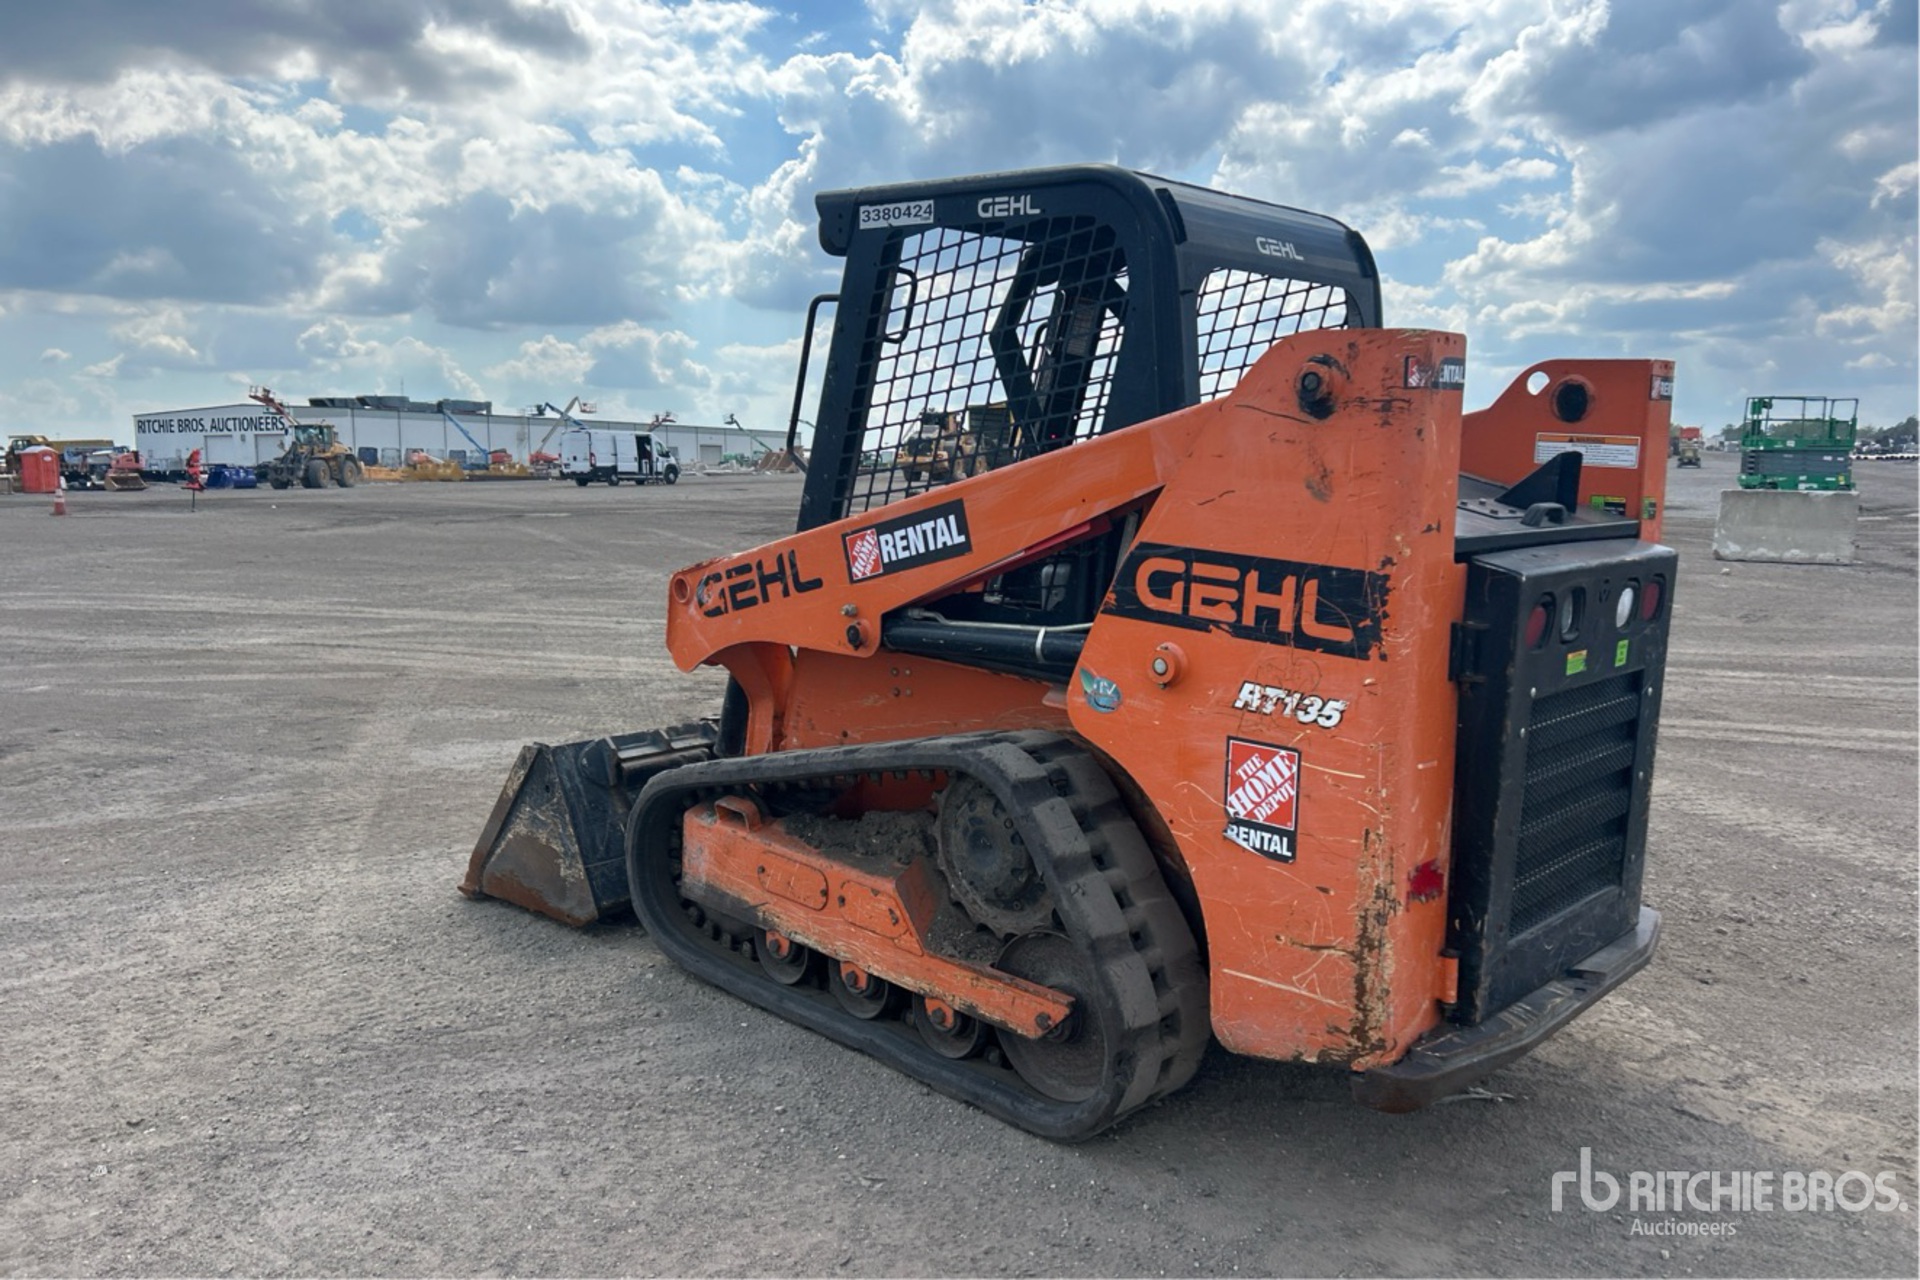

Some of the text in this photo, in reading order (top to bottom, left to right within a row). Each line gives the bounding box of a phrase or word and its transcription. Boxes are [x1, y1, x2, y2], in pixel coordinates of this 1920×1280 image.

[861, 203, 933, 222] 3380424
[977, 195, 1041, 218] GEHL
[1256, 236, 1304, 260] GEHL
[137, 416, 285, 434] RITCHIE BROS. AUCTIONEERS
[879, 514, 965, 563] RENTAL
[696, 549, 823, 617] GEHL
[1135, 557, 1354, 642] GEHL
[1232, 680, 1348, 729] RT135
[1227, 750, 1296, 818] HOME
[1236, 753, 1265, 781] THE
[1253, 780, 1295, 822] DEPOT
